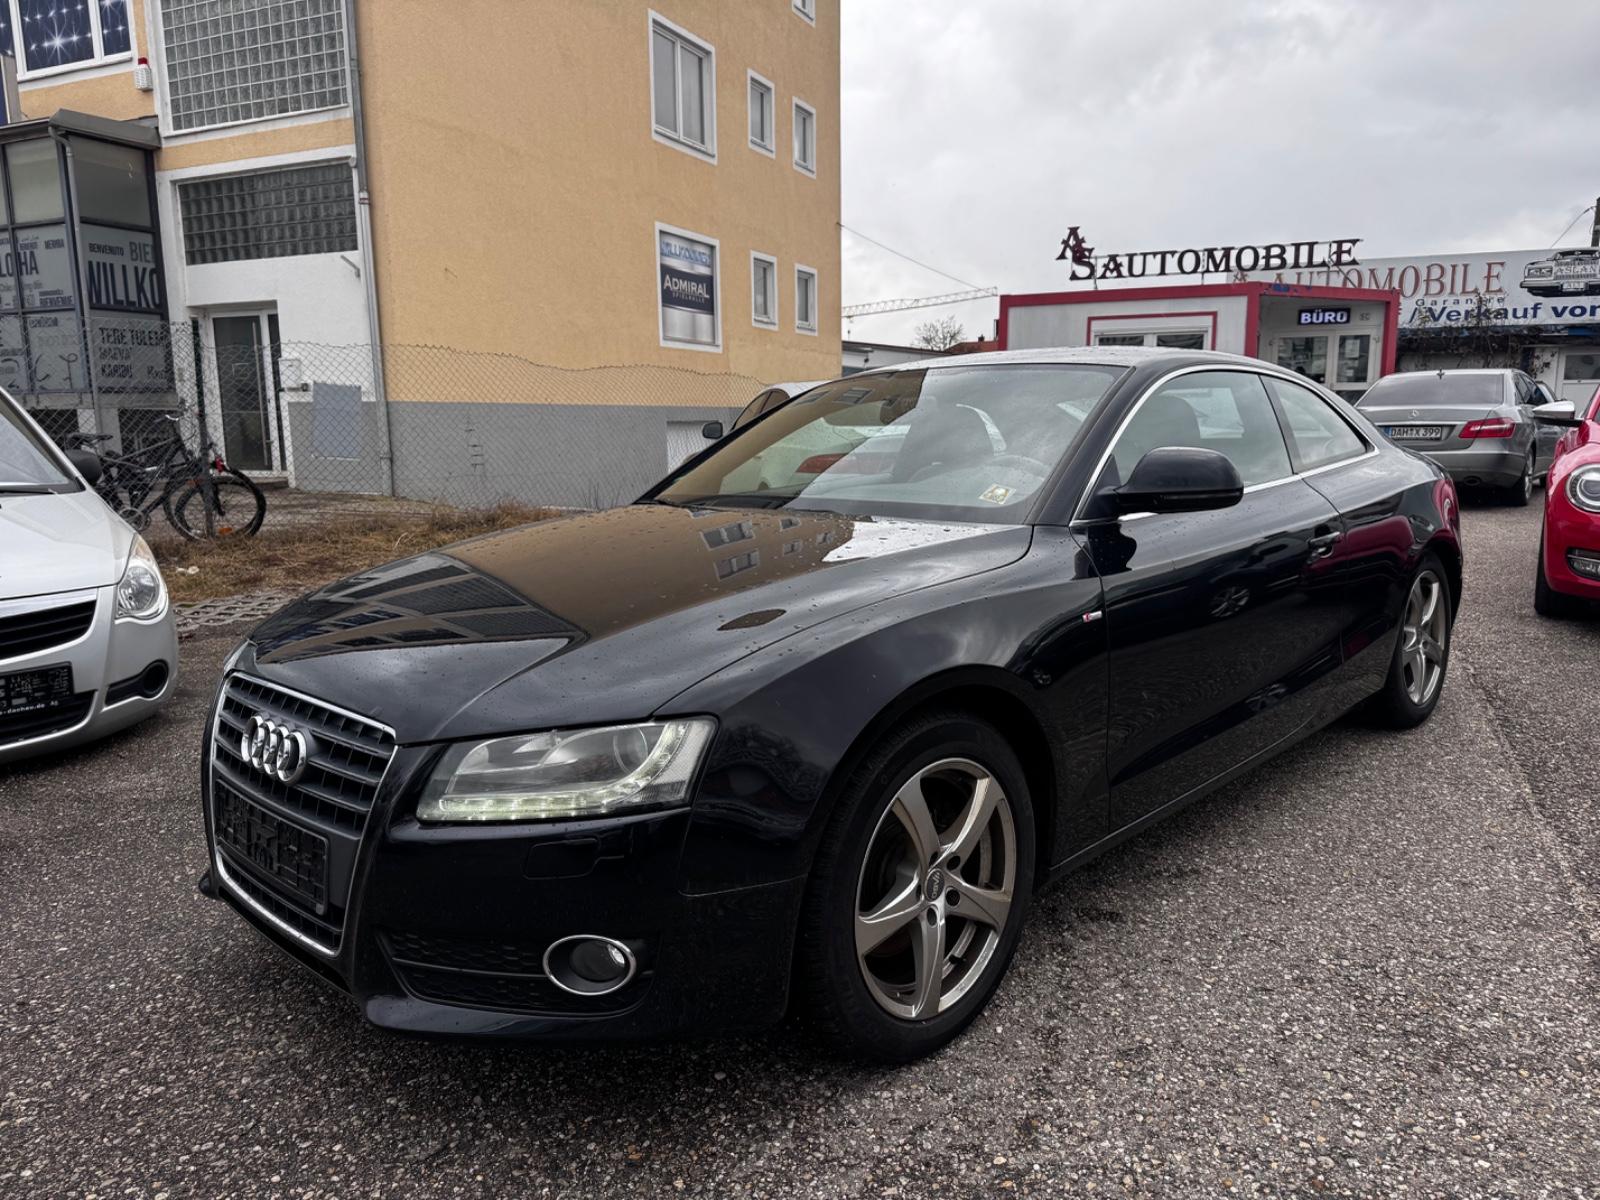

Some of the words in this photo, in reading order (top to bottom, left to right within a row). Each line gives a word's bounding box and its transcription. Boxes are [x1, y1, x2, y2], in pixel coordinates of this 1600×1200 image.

[1097, 239, 1363, 279] AUTOMOBILE
[663, 273, 710, 298] ADMIRAL
[1300, 309, 1348, 324] BÜRO
[1392, 427, 1408, 437] DAH
[1422, 427, 1441, 437] 399
